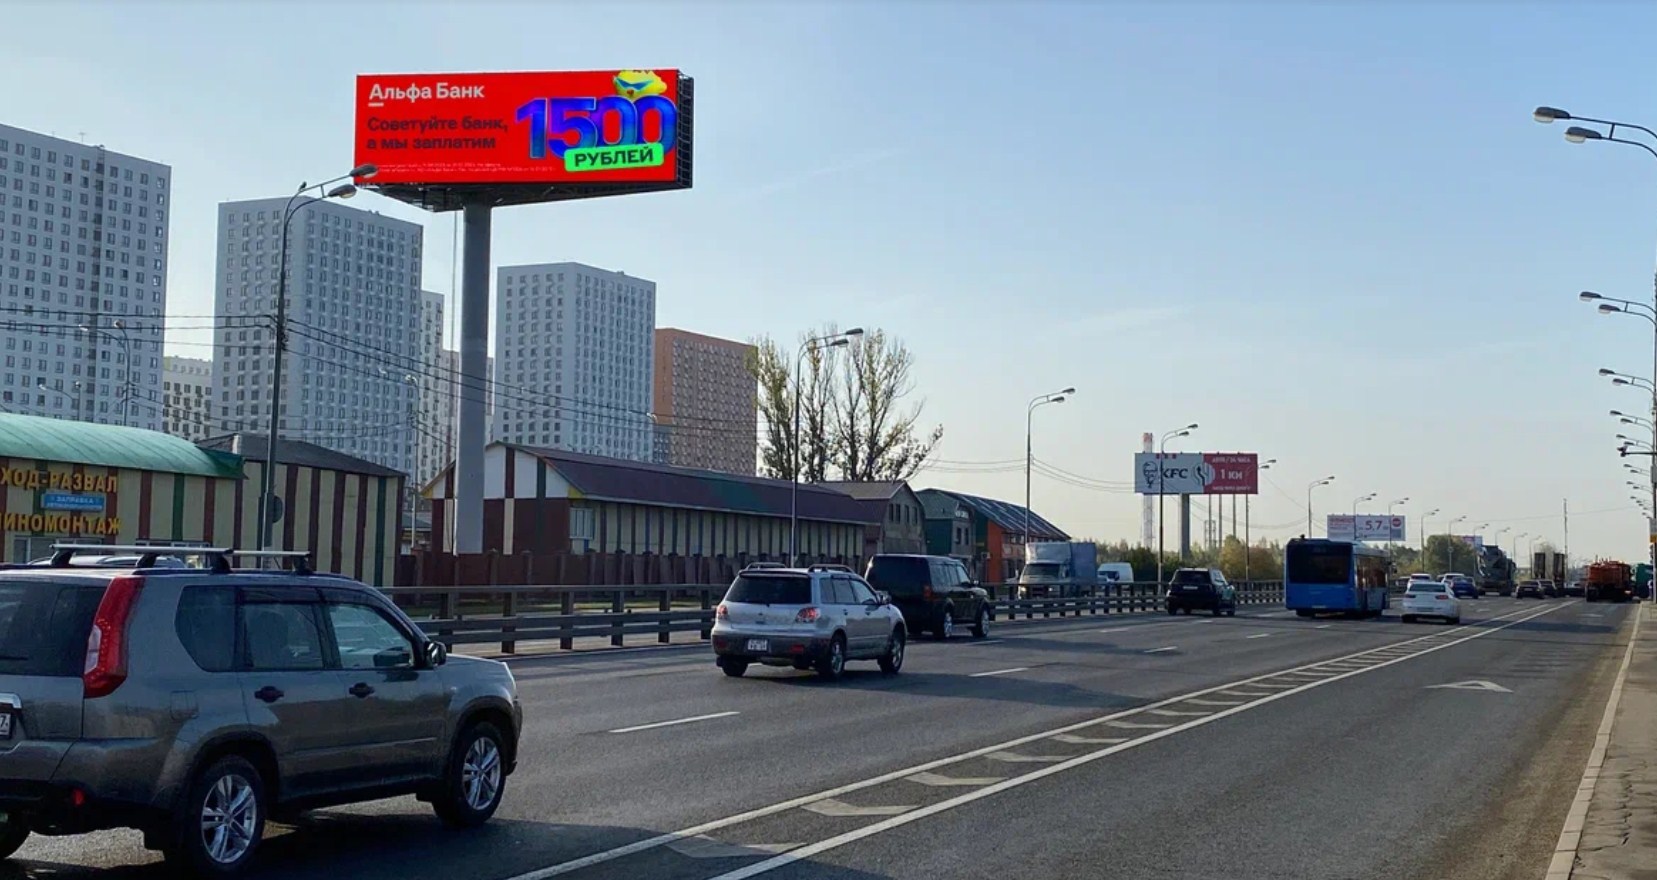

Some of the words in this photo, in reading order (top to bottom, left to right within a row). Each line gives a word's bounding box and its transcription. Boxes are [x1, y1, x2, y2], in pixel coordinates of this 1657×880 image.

[368, 83, 432, 103] Альфа
[436, 82, 485, 99] Банк
[367, 116, 457, 134] Советуйте
[462, 116, 508, 132] банк,
[515, 95, 677, 159] 1500
[367, 139, 376, 149] а
[381, 139, 407, 149] мы
[412, 138, 496, 149] заплатим
[574, 147, 654, 167] РУБЛЕЙ
[1162, 468, 1188, 479] KFC
[1220, 468, 1226, 479] 1
[0, 512, 120, 534] ИНОМОНТАЖ
[1365, 520, 1383, 531] 5,7
